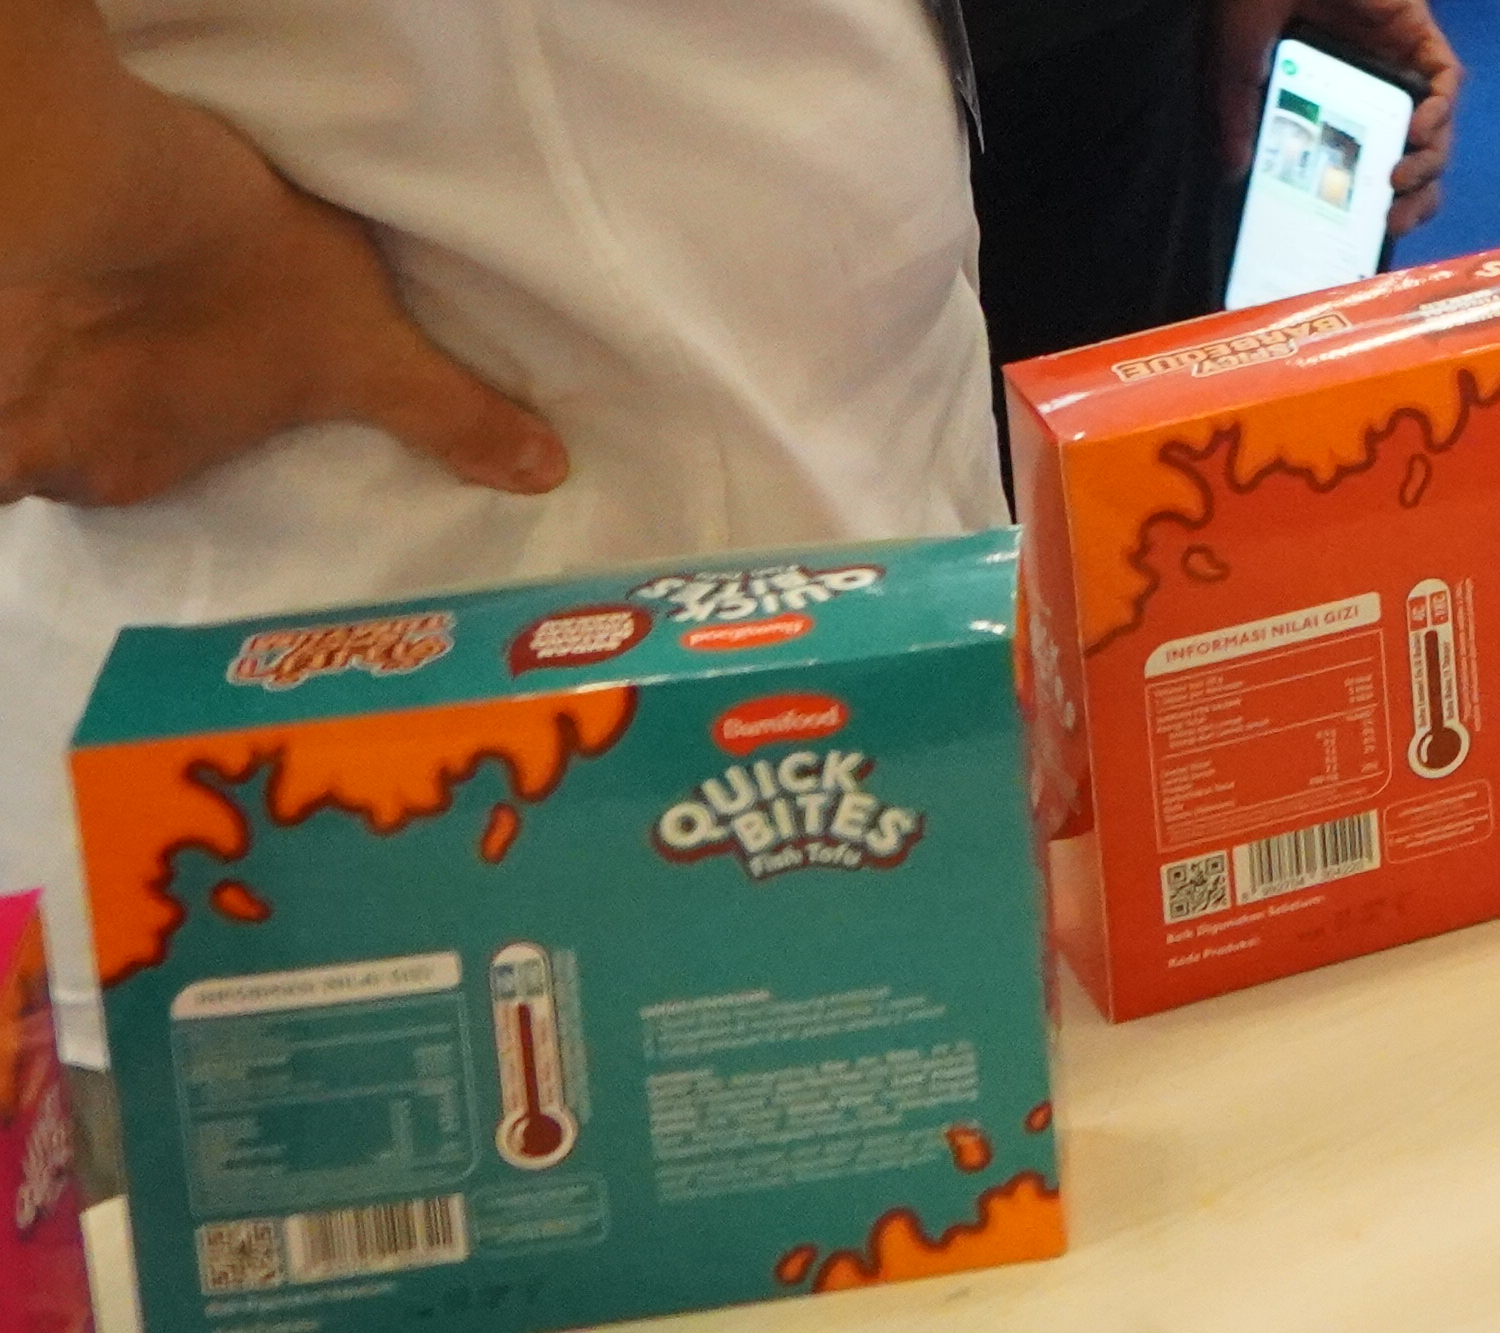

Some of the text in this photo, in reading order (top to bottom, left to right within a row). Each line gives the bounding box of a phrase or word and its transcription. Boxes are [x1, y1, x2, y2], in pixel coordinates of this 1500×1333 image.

[1114, 314, 1351, 380] BARBEQUE
[1165, 604, 1359, 664] INFORMASI NILAI GIZI
[659, 749, 865, 848] QUICK
[731, 792, 915, 857] BITES
